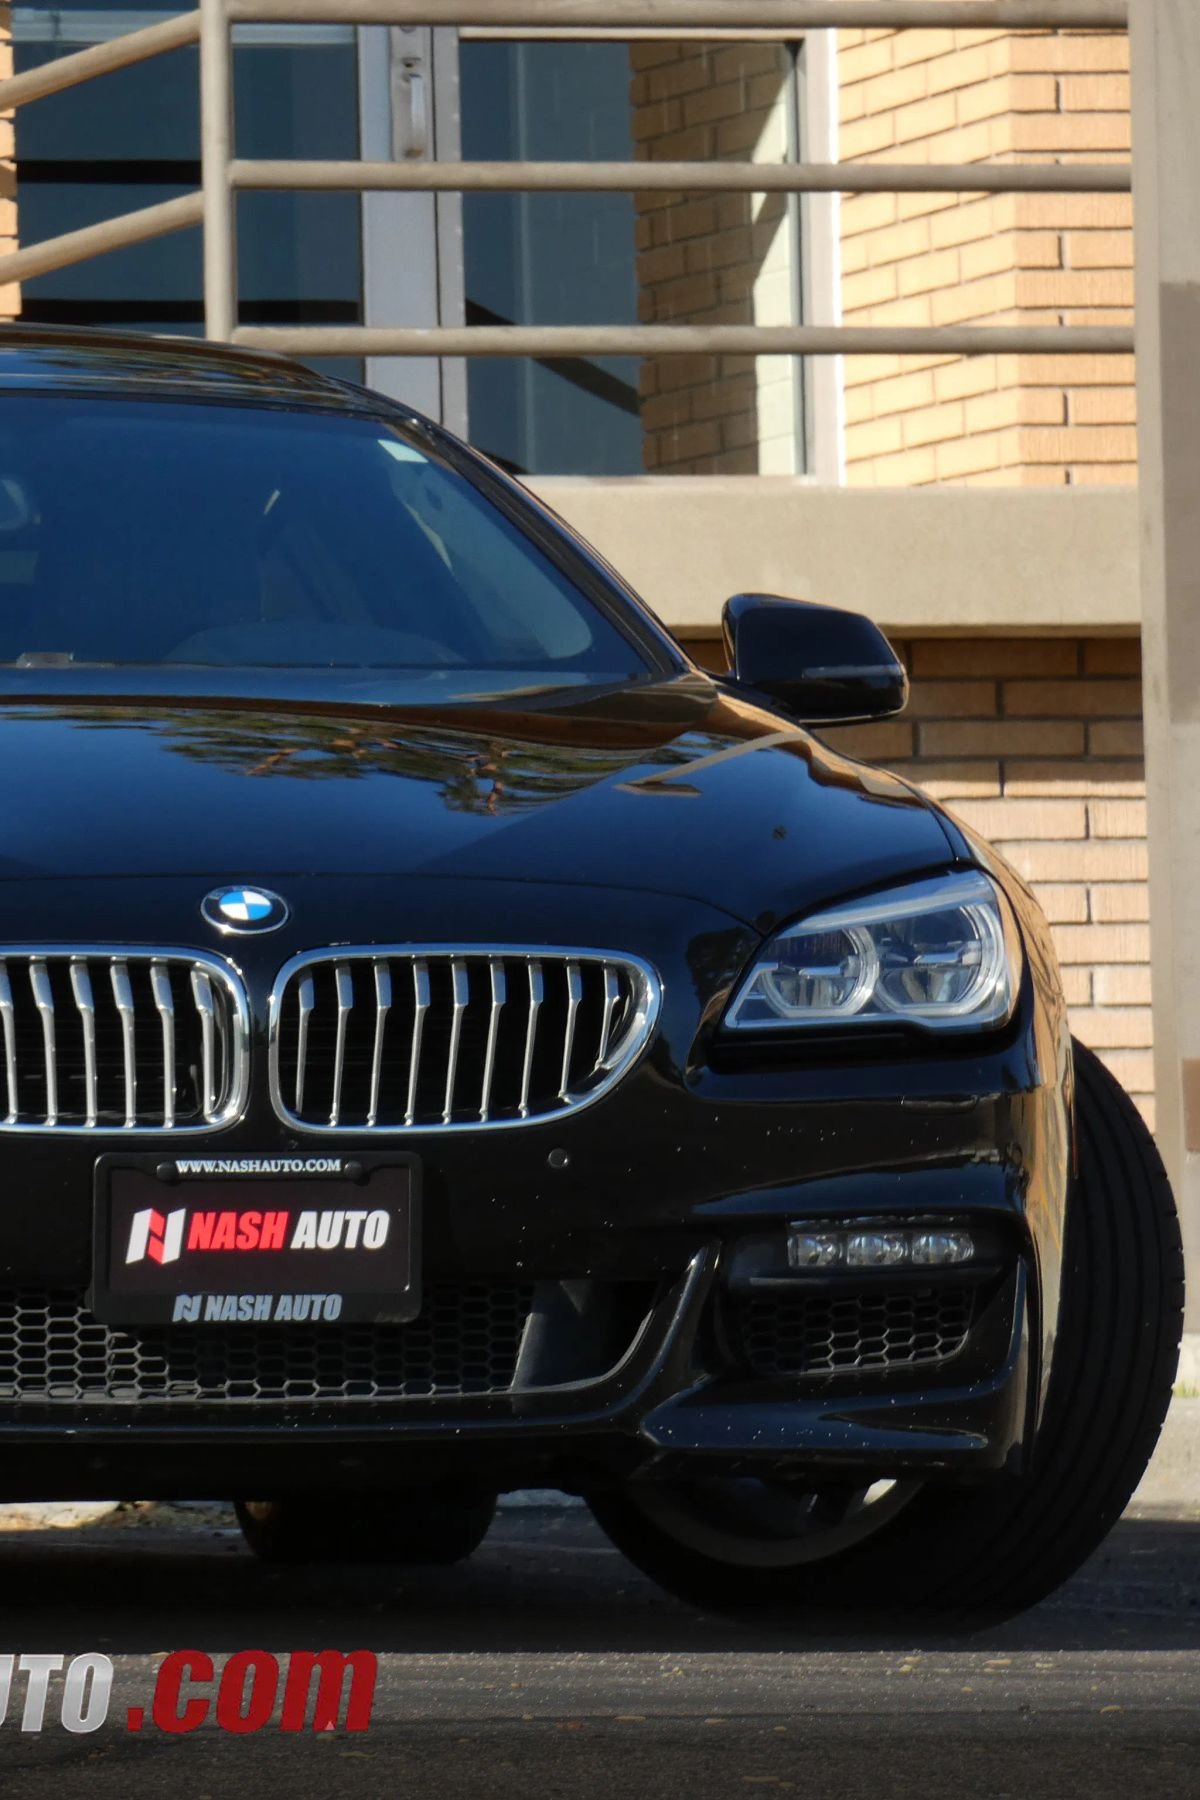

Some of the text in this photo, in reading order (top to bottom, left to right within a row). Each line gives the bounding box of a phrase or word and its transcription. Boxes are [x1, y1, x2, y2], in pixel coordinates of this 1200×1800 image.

[176, 1159, 341, 1173] WWW.NASHAUTO.COM
[187, 1211, 291, 1250] NASH
[290, 1210, 390, 1249] AUTO
[204, 1295, 274, 1321] NASH
[274, 1294, 342, 1321] AUTO
